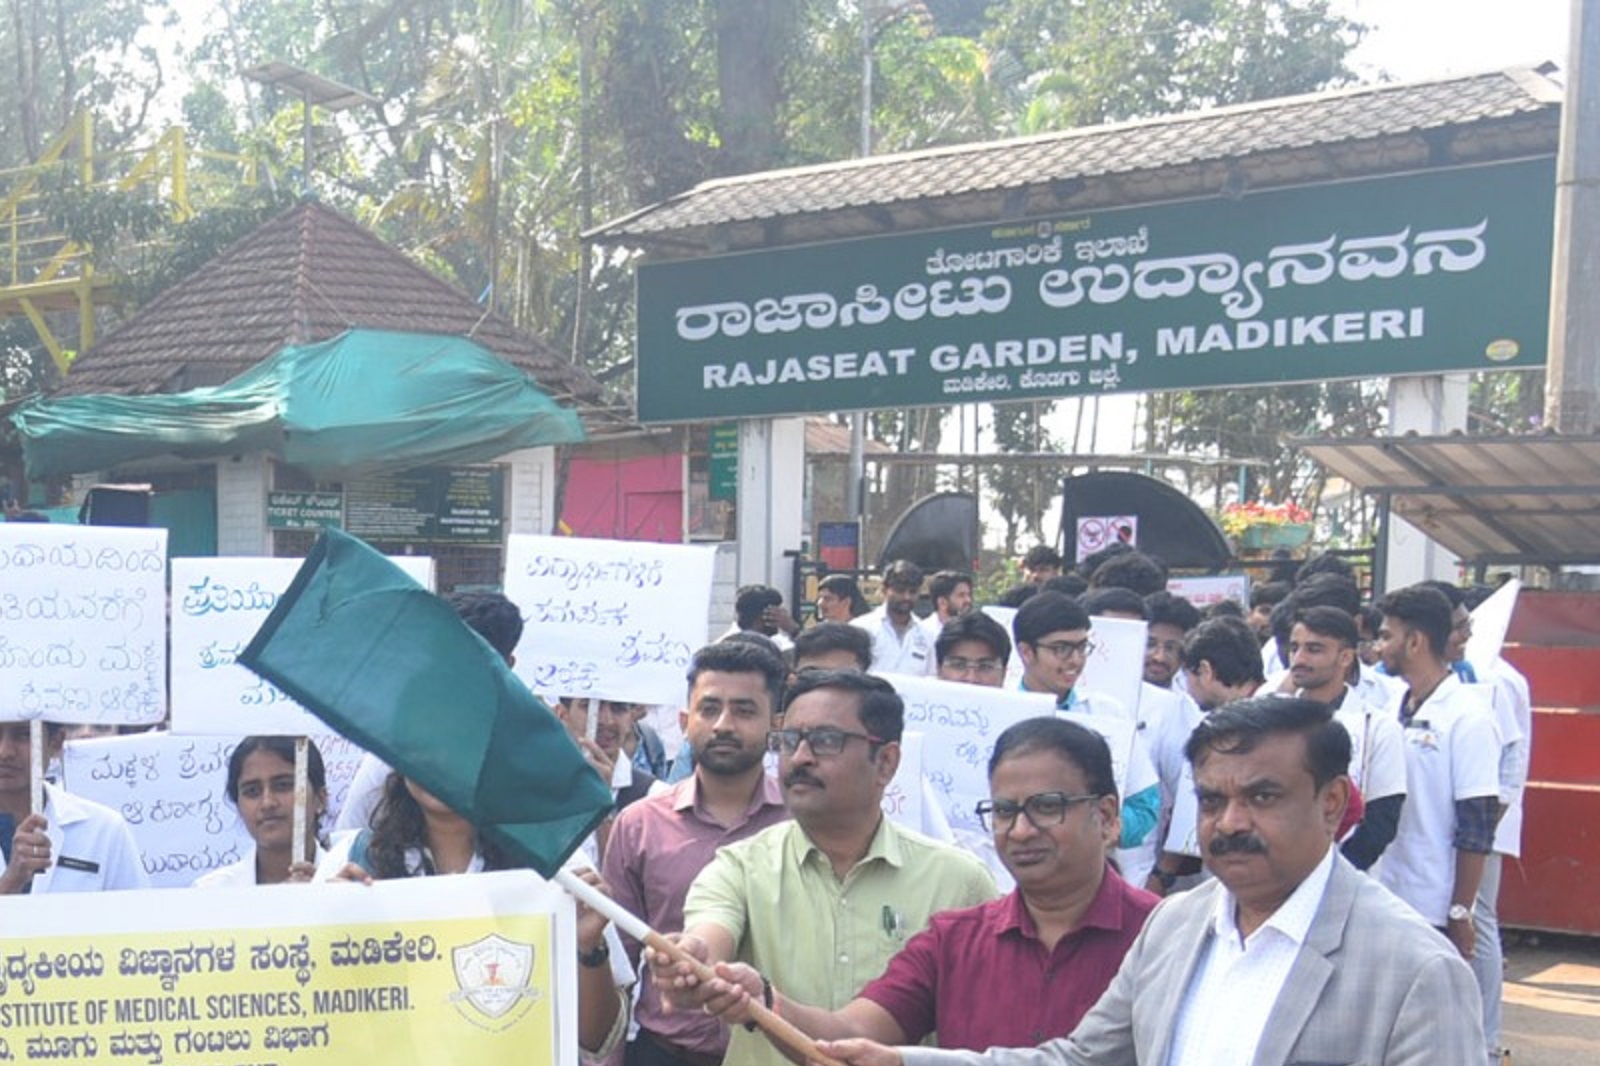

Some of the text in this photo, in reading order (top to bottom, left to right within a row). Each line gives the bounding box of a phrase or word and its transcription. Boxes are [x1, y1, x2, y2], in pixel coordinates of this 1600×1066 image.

[675, 216, 1489, 341] ರಾಜಾಸೀಟು ಉದ್ಯಾನವನ
[702, 307, 1426, 390] RAJASEAT GARDEN, MADIKERI
[268, 507, 341, 518] TICKET COUNTER
[118, 938, 235, 991] ವಿಜ್ಞಾನಗಳ
[85, 1000, 108, 1025] OF
[115, 997, 200, 1024] MEDICAL
[206, 991, 306, 1019] SCIENCES,
[313, 986, 416, 1015] MADIKERI.
[26, 1032, 98, 1061] ಮೂಗು
[109, 1029, 163, 1065] ಮತ್ತು
[174, 1026, 252, 1056] ಗಂಟಲು
[263, 1022, 330, 1053] ವಿಭಾಗ
